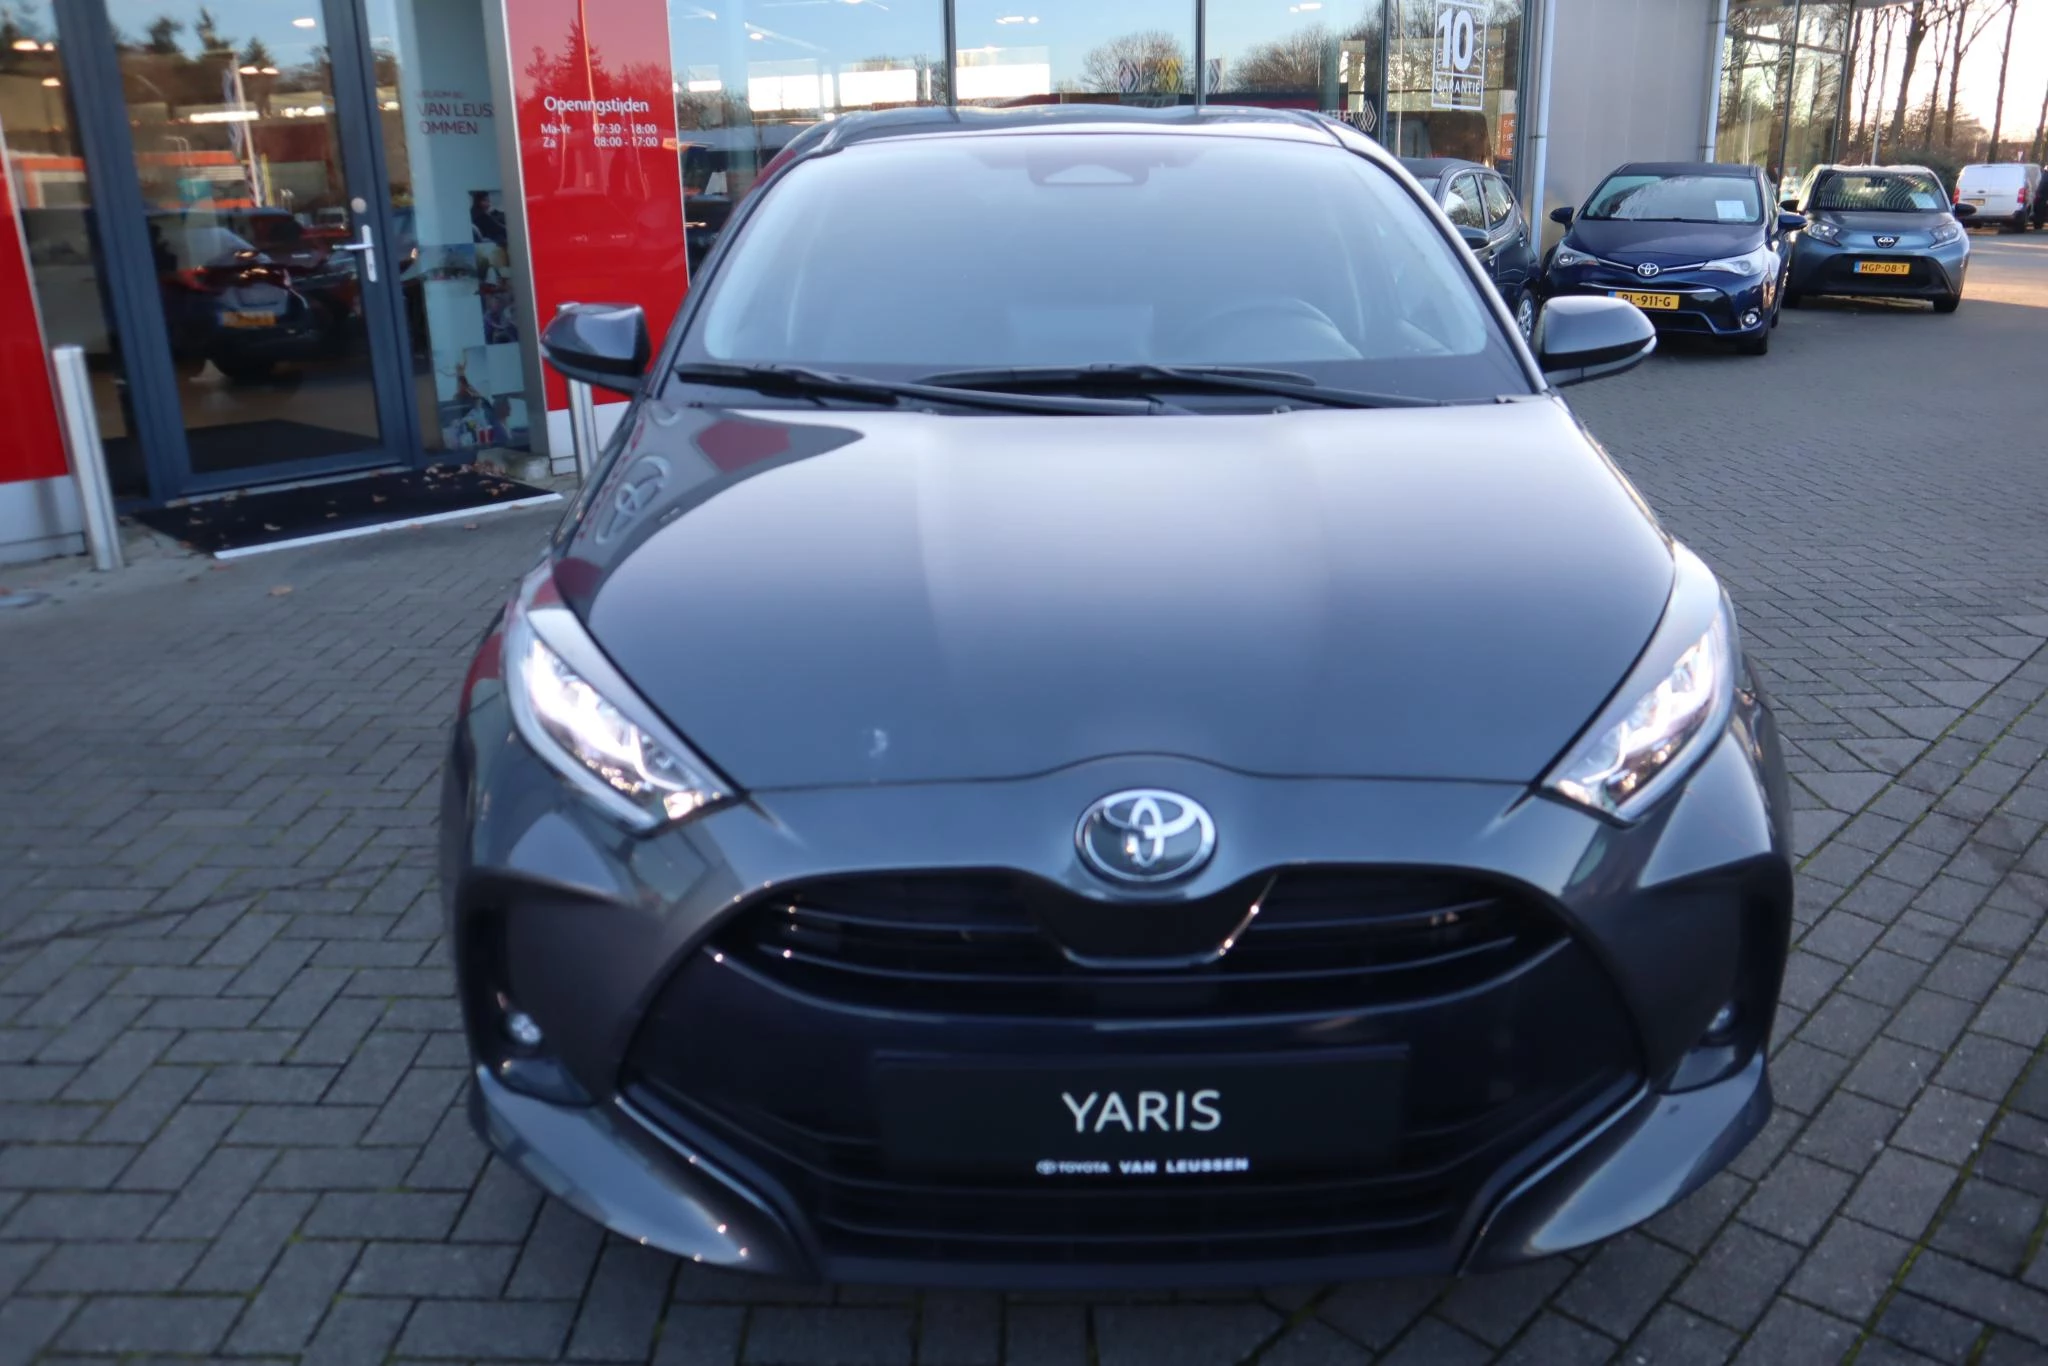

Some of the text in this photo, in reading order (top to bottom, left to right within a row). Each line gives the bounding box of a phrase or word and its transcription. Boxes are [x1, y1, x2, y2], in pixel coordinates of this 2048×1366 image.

[1437, 7, 1474, 73] 10
[1435, 79, 1481, 96] GARANTIE
[416, 102, 451, 117] VAN
[543, 95, 649, 116] Openingstijden
[592, 123, 621, 134] 07:30
[631, 123, 657, 134] 18:00
[543, 136, 557, 148] Za
[593, 136, 622, 147] 08:00
[632, 136, 659, 147] 17:00
[1061, 1088, 1223, 1133] YARIS
[1058, 1157, 1249, 1174] TOYOTA VAN LEUSSEN
